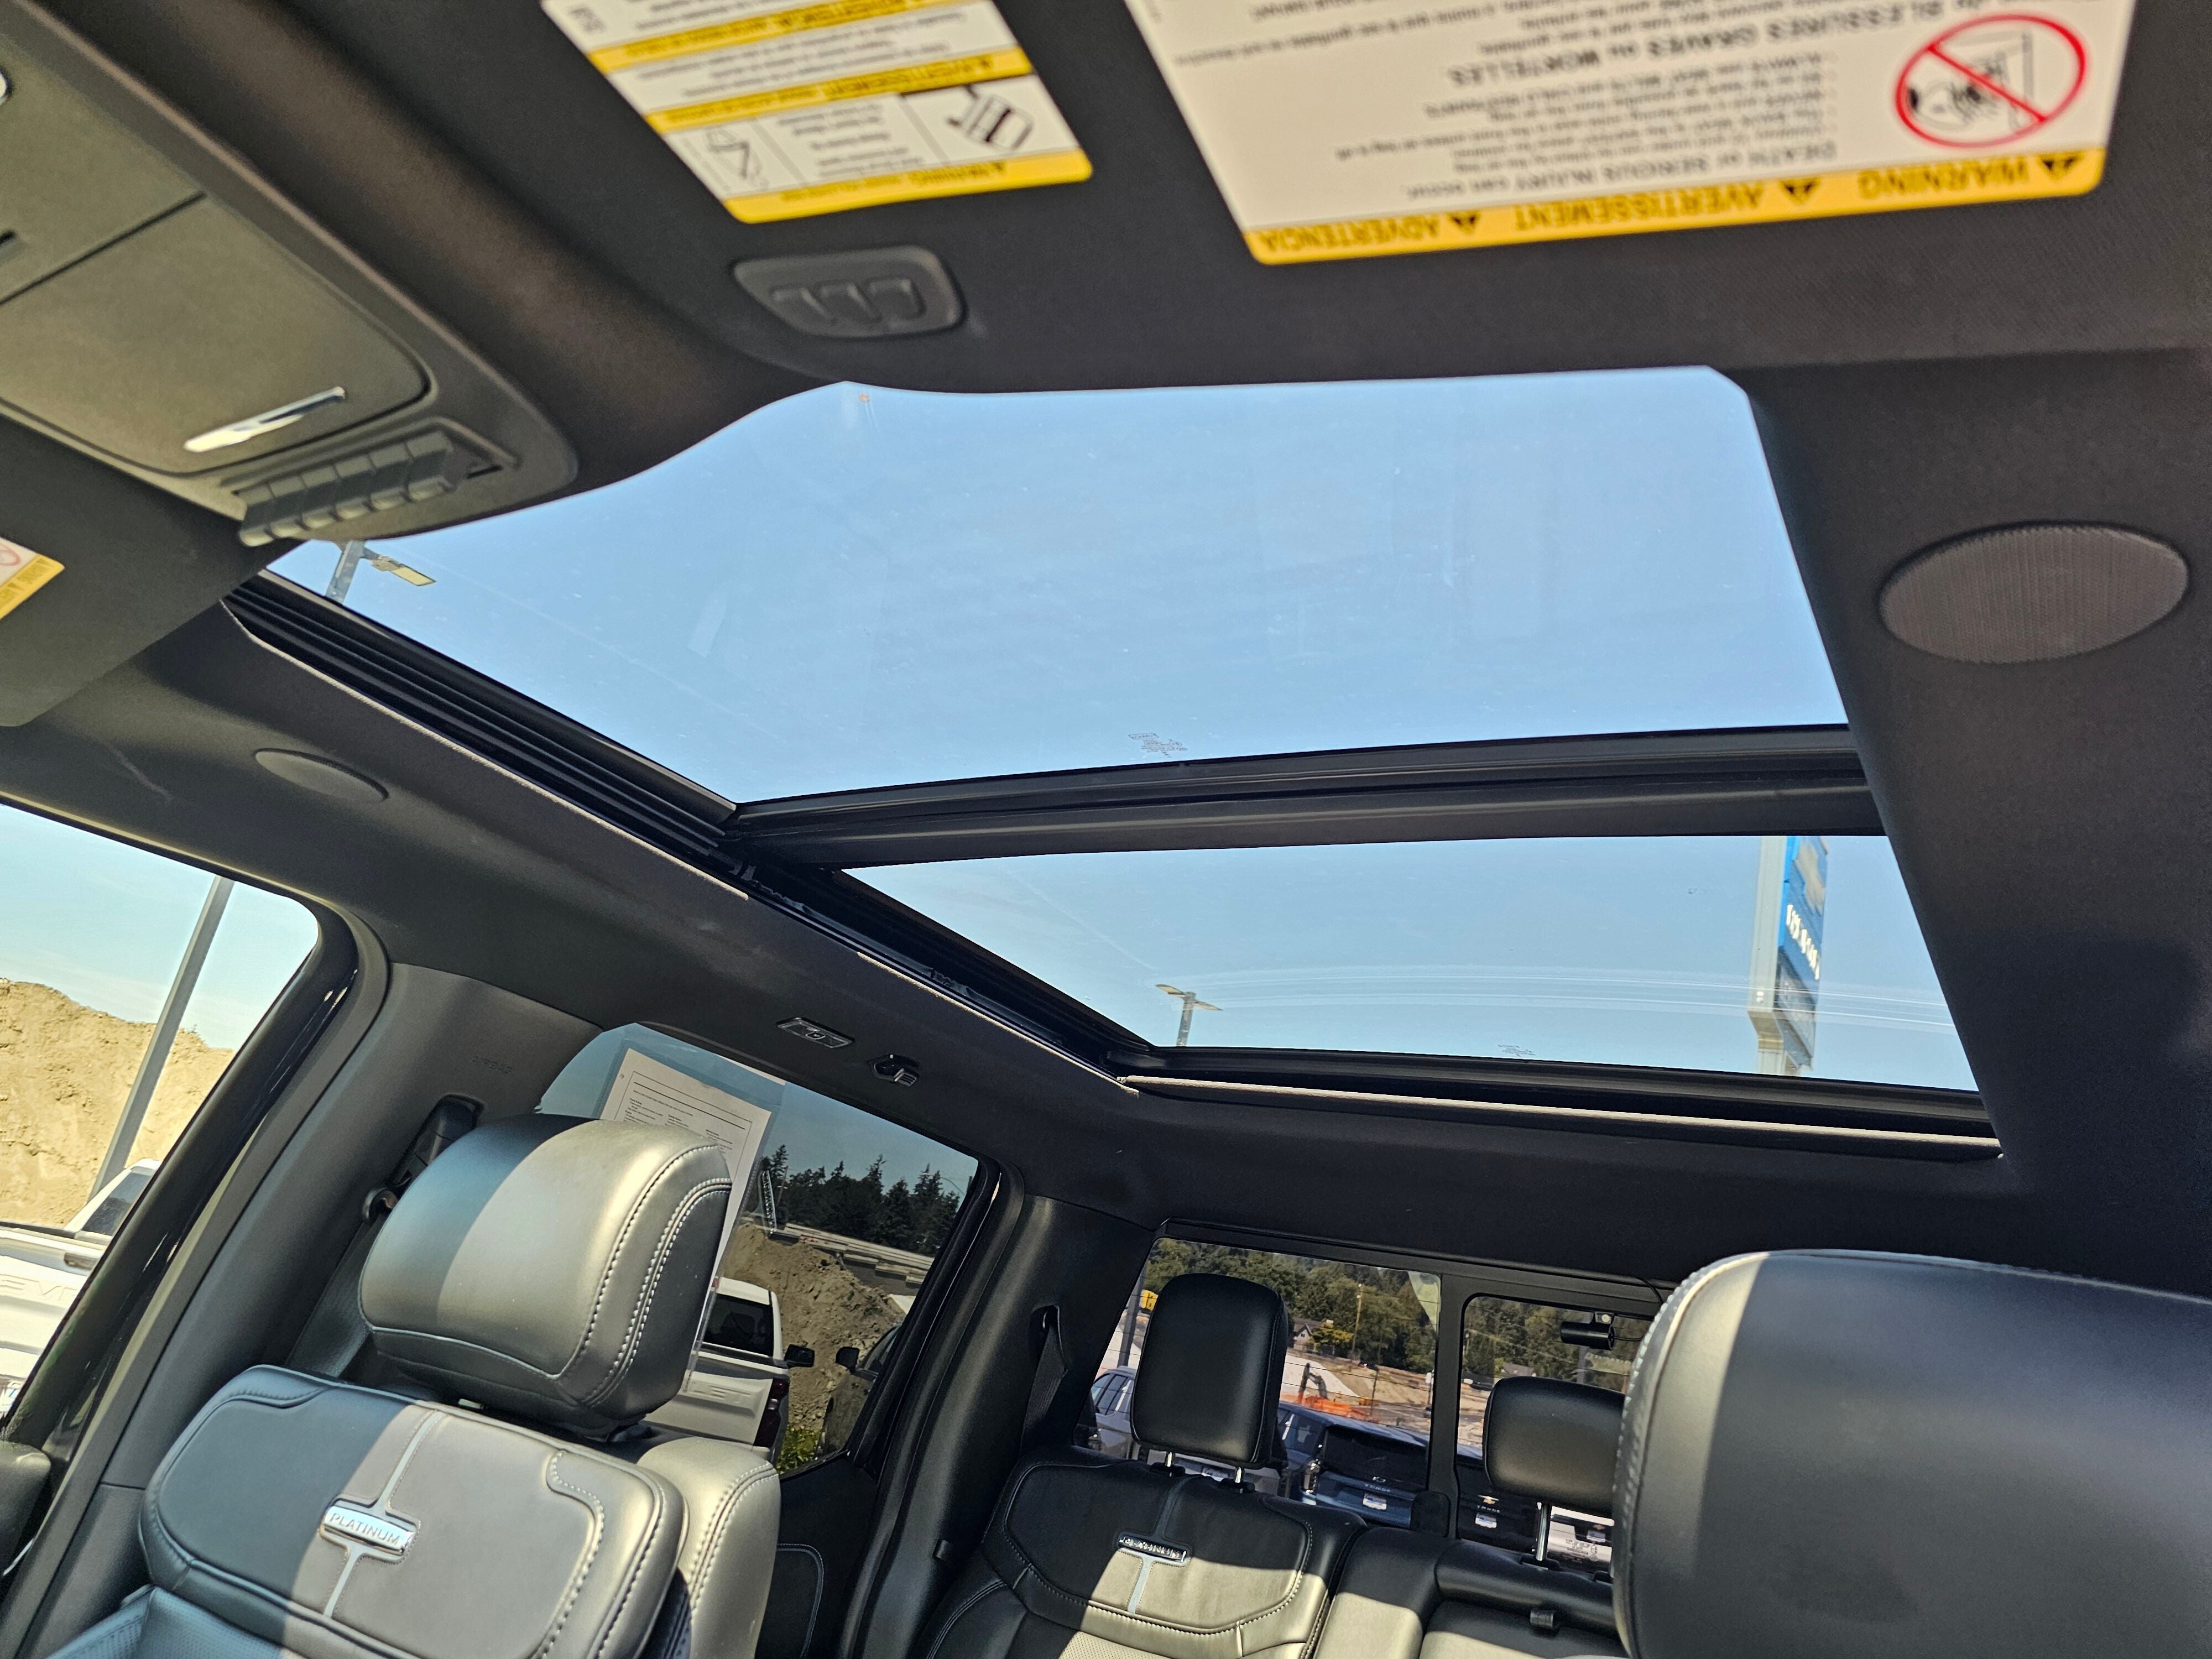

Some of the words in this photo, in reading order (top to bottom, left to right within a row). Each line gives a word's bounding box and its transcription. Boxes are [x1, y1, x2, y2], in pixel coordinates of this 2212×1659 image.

[1857, 156, 2028, 200] WARNING
[1514, 184, 1766, 232] AVERTISSEMENT
[1259, 215, 1439, 252] ADVERTENCIA
[330, 1512, 400, 1545] PLATINUM
